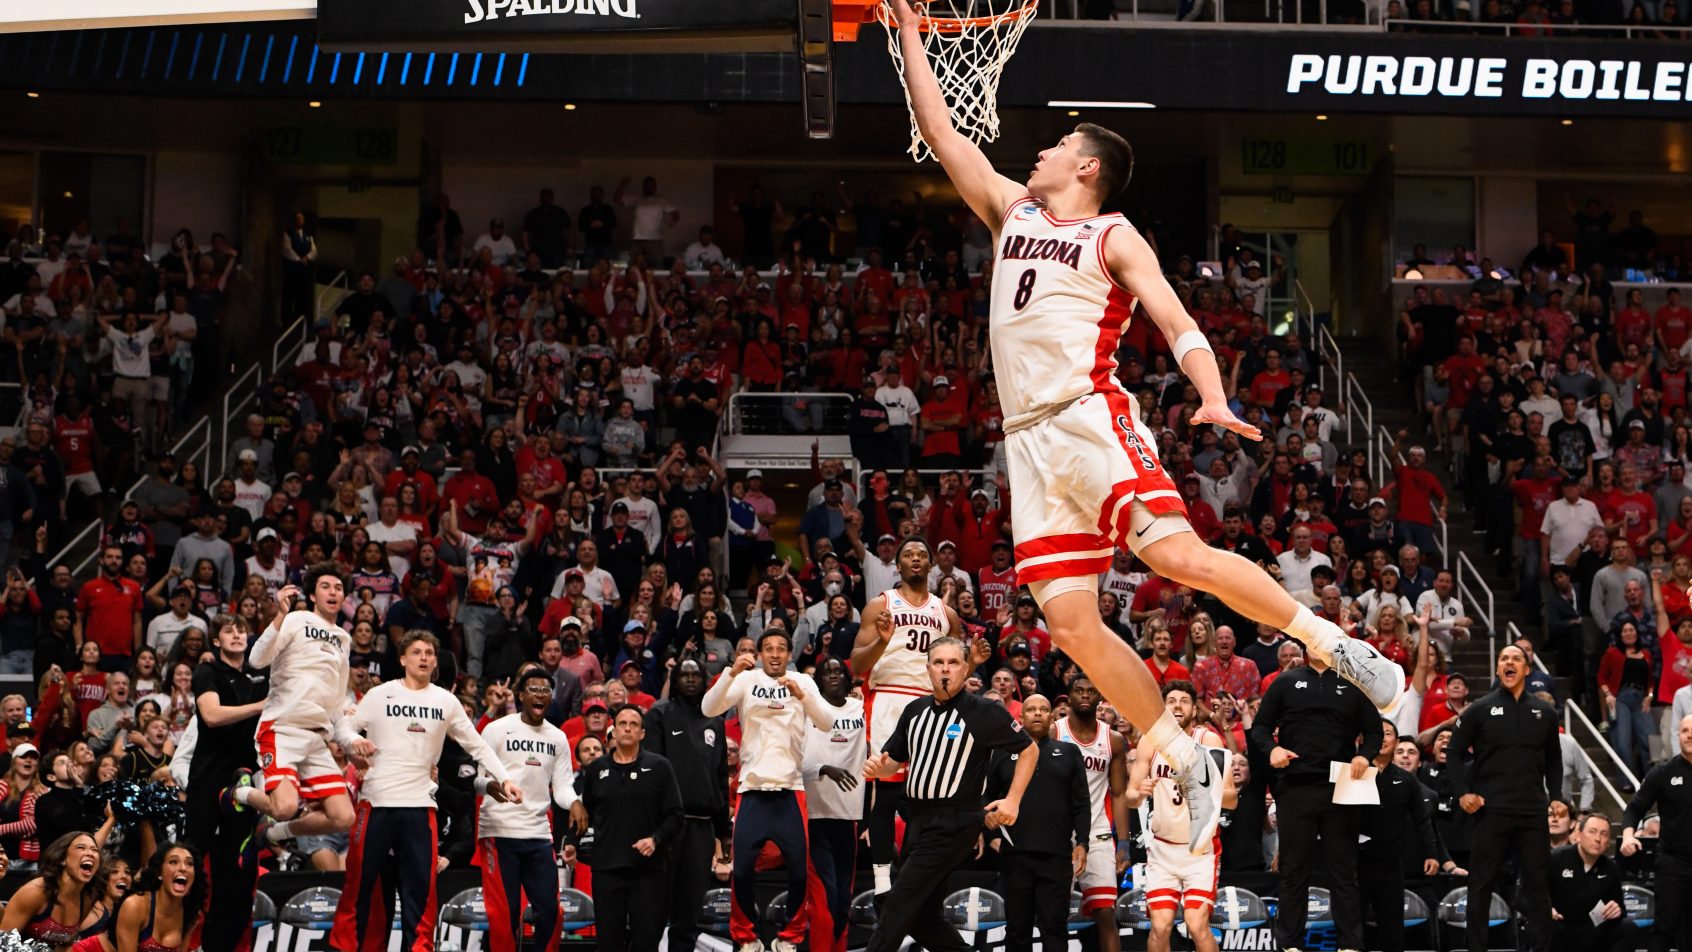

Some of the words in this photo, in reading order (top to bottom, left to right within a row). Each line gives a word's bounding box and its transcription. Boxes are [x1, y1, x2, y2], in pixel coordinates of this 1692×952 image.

[1286, 54, 1507, 97] PURDUE
[1522, 58, 1692, 101] BOILE
[266, 128, 301, 157] 127
[353, 129, 392, 158] 128
[1248, 141, 1286, 169] 128
[1334, 142, 1367, 170] 101
[1002, 235, 1082, 271] ARIZONA
[1014, 268, 1036, 311] 8
[71, 437, 80, 451] 5
[1117, 415, 1155, 470] CATS
[985, 593, 1003, 609] 30
[894, 613, 942, 632] ARIZONA
[906, 629, 930, 653] 30
[778, 687, 788, 699] IT
[386, 704, 417, 718] LOCK
[420, 706, 429, 719] IT
[506, 739, 534, 752] LOCK
[536, 741, 546, 753] IT
[1223, 927, 1277, 951] MAR
